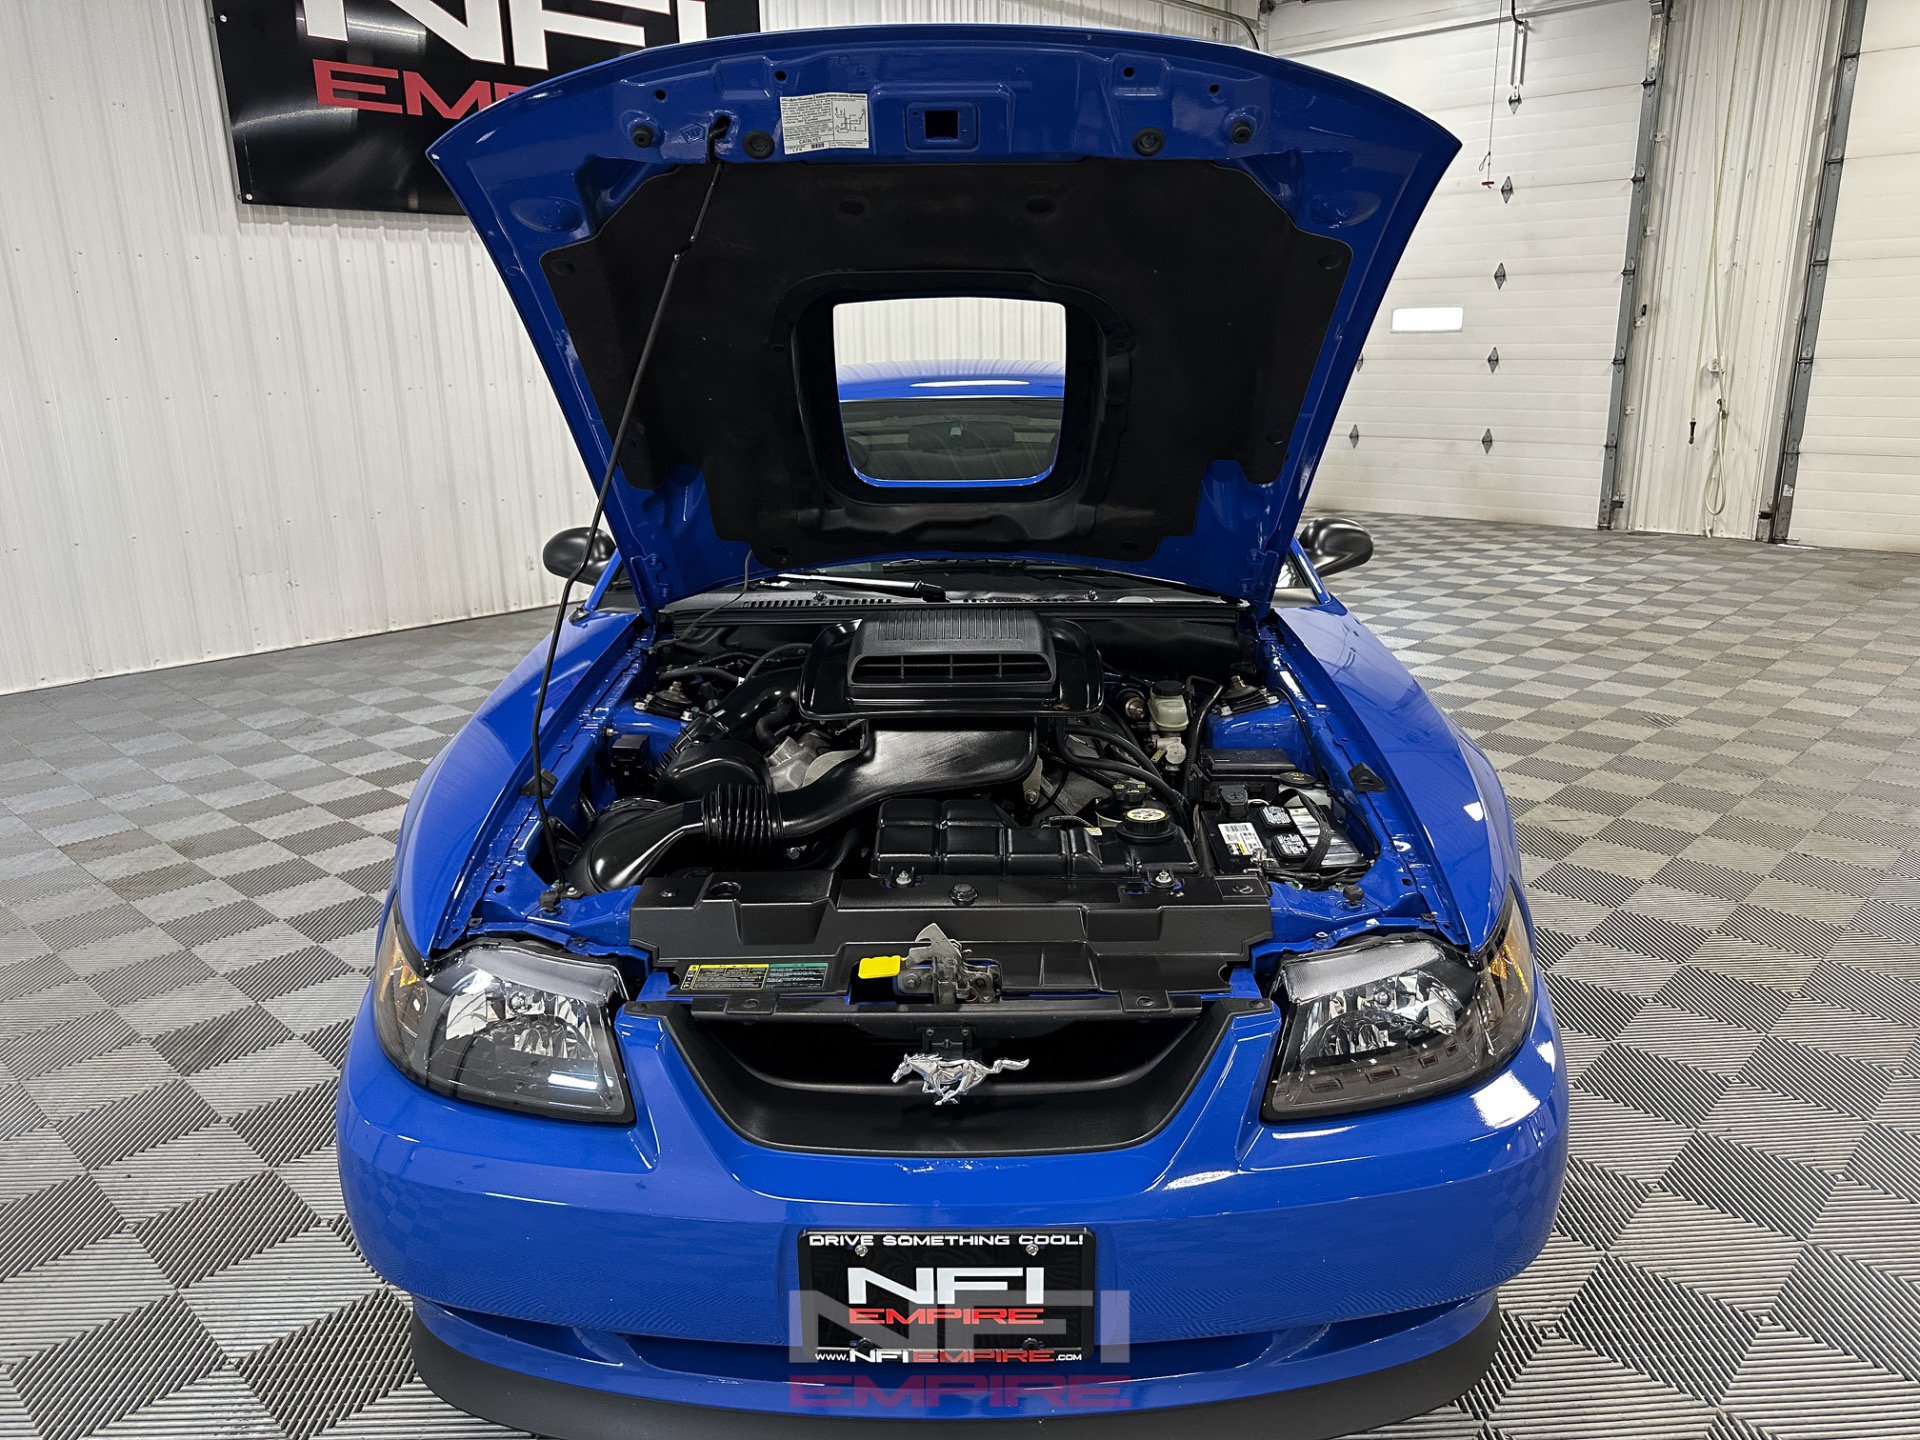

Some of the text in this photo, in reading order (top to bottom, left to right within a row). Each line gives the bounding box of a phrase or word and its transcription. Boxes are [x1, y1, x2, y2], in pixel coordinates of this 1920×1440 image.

[809, 1234, 1084, 1246] DRIVE SOMETHING COOL!
[847, 1267, 1045, 1305] NFI
[849, 1308, 1045, 1325] EMPIRE
